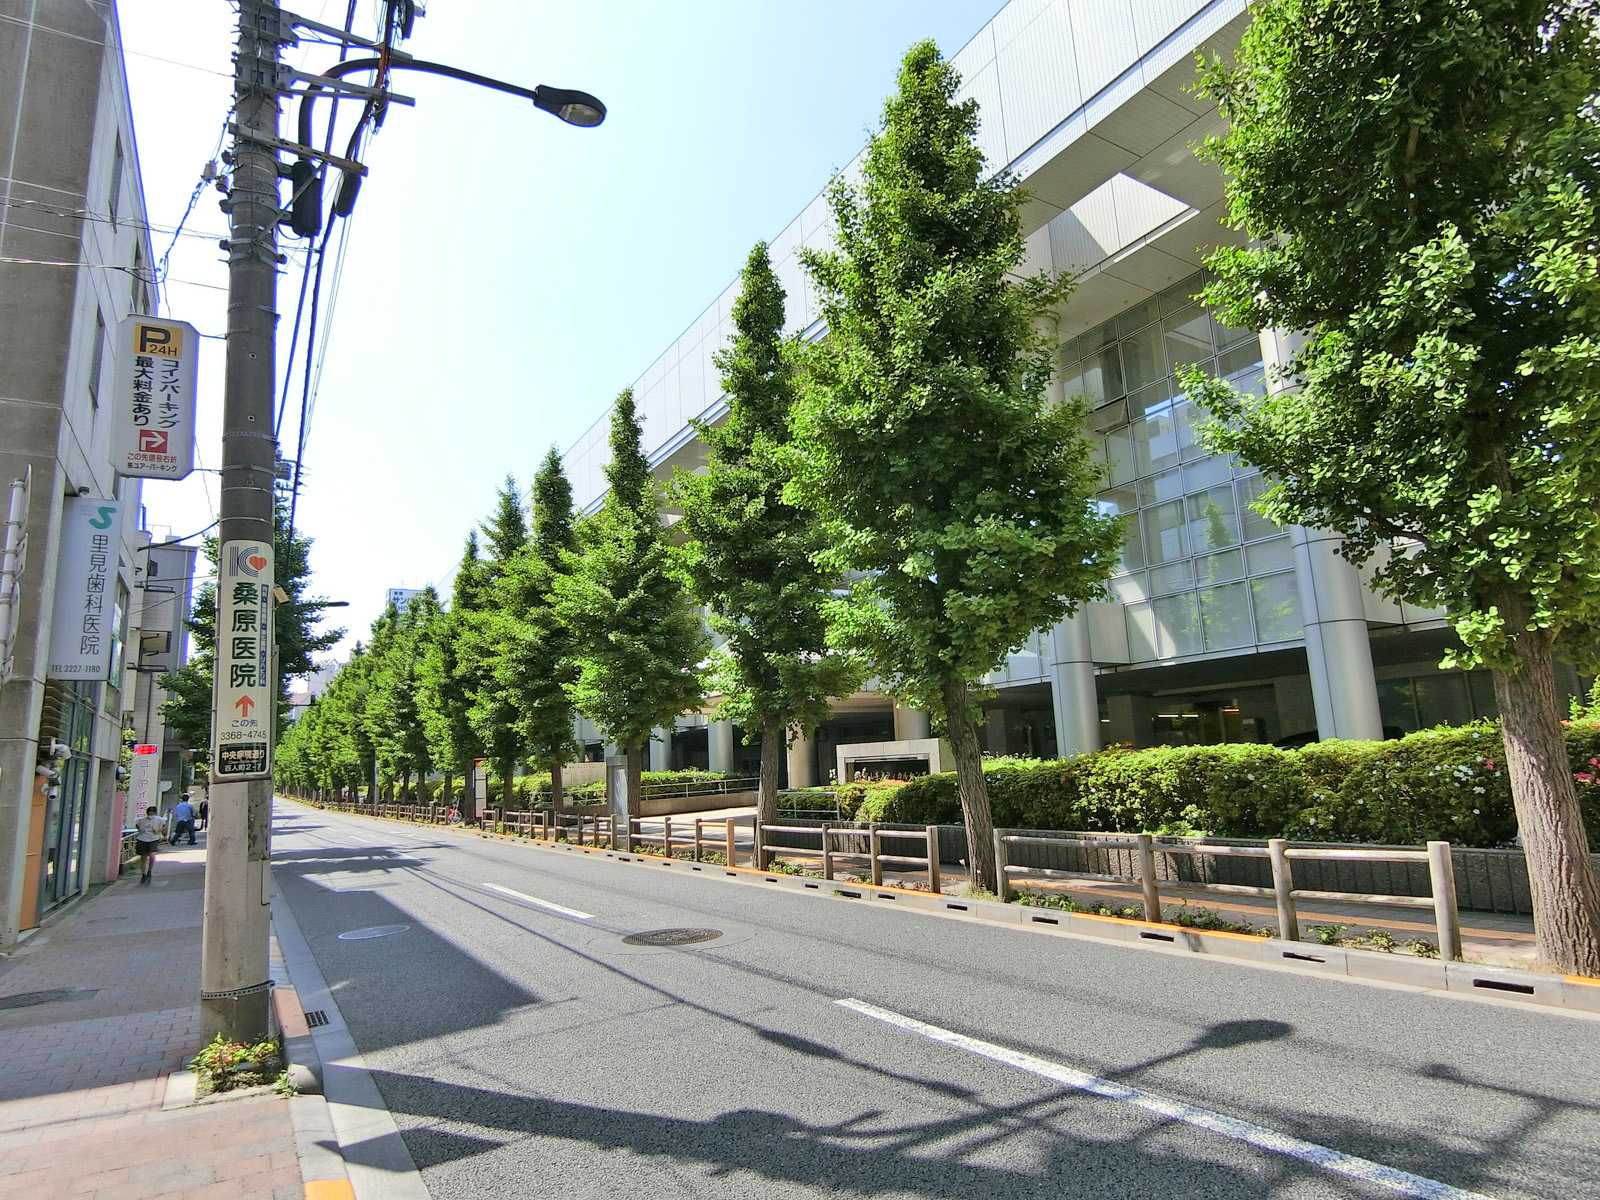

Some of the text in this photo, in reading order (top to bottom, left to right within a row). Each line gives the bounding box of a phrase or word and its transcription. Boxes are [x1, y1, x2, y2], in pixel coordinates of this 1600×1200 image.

[140, 325, 171, 353] P
[149, 344, 178, 357] 24H
[132, 355, 154, 427] 最大料金あり
[157, 358, 181, 429] コインパーキング
[80, 534, 109, 656] 里見歯科医院
[230, 582, 259, 688] 桑原医院
[51, 664, 101, 673] TEL 3227-1180
[220, 730, 267, 741] 3368-4745
[231, 719, 258, 728] この先
